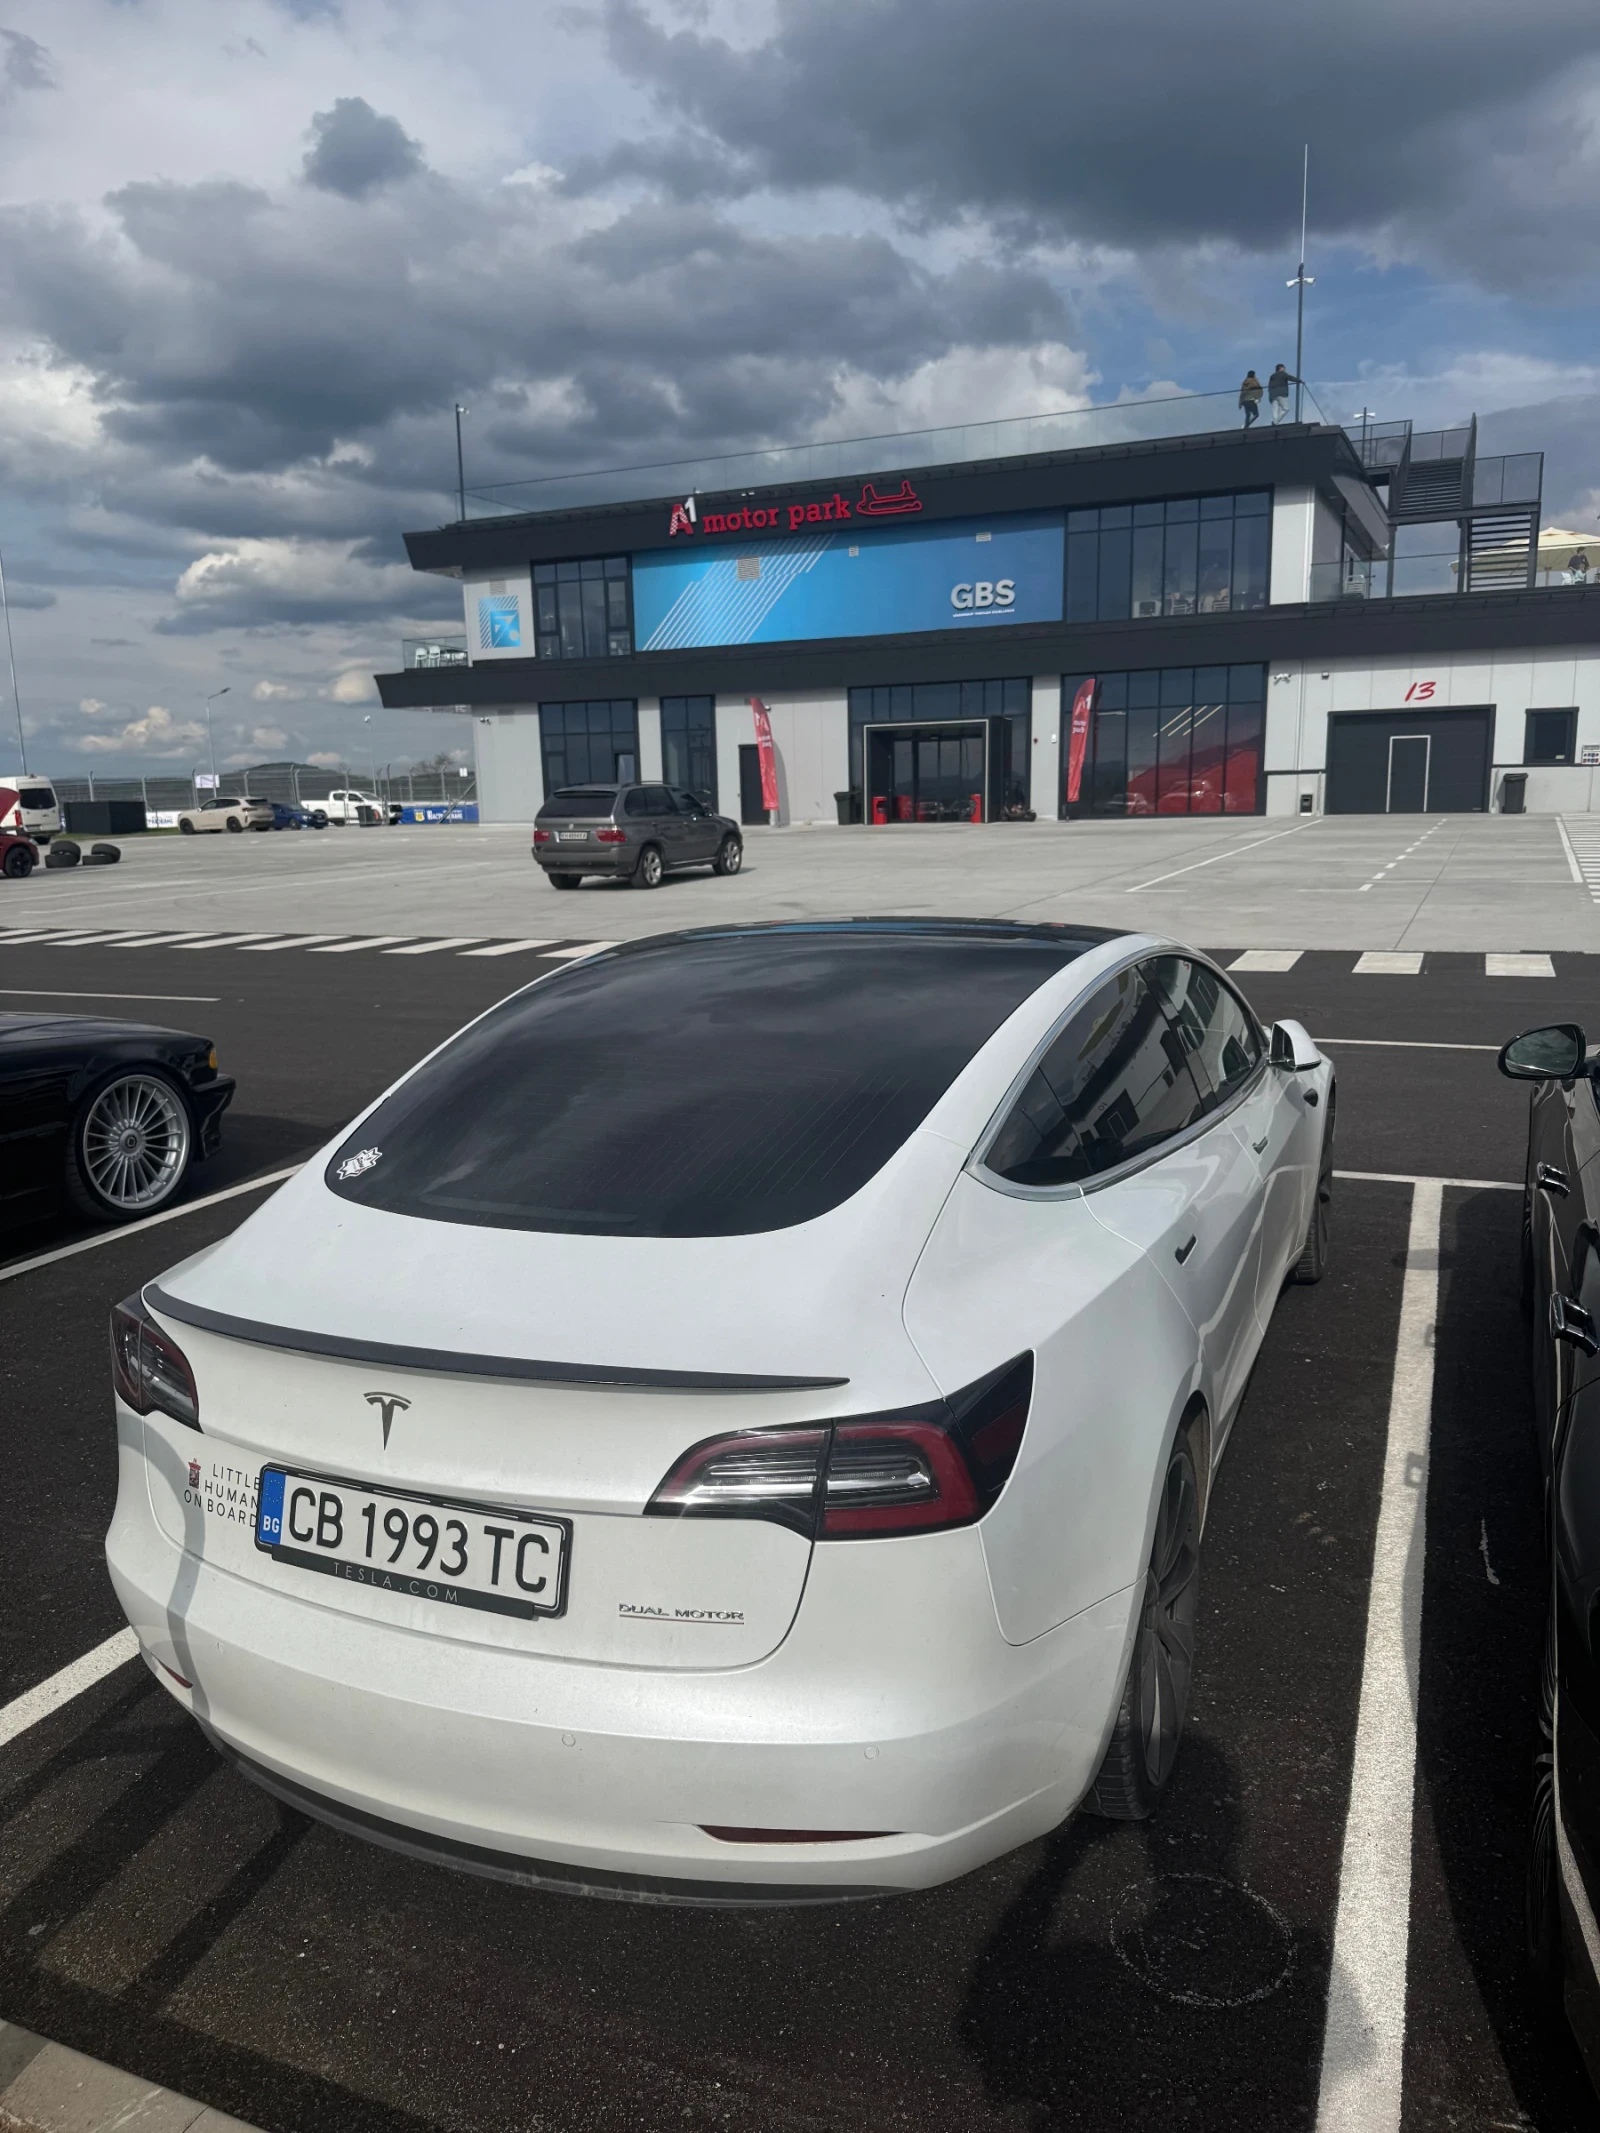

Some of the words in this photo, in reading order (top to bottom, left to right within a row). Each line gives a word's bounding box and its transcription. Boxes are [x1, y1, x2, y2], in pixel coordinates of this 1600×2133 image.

[669, 496, 697, 537] A1
[702, 507, 779, 533] motor
[787, 494, 851, 530] park
[951, 579, 1016, 609] GBS
[1404, 681, 1436, 702] 13
[212, 1463, 261, 1491] LITTLE
[184, 1489, 202, 1508] ON
[207, 1498, 257, 1528] BOARD
[263, 1515, 280, 1533] BG
[289, 1487, 343, 1549] CB
[361, 1502, 469, 1577] 1993
[483, 1525, 550, 1593] TC
[333, 1562, 458, 1603] TESLA.COM
[619, 1603, 669, 1617] DUAL
[675, 1609, 744, 1620] MOTOR
